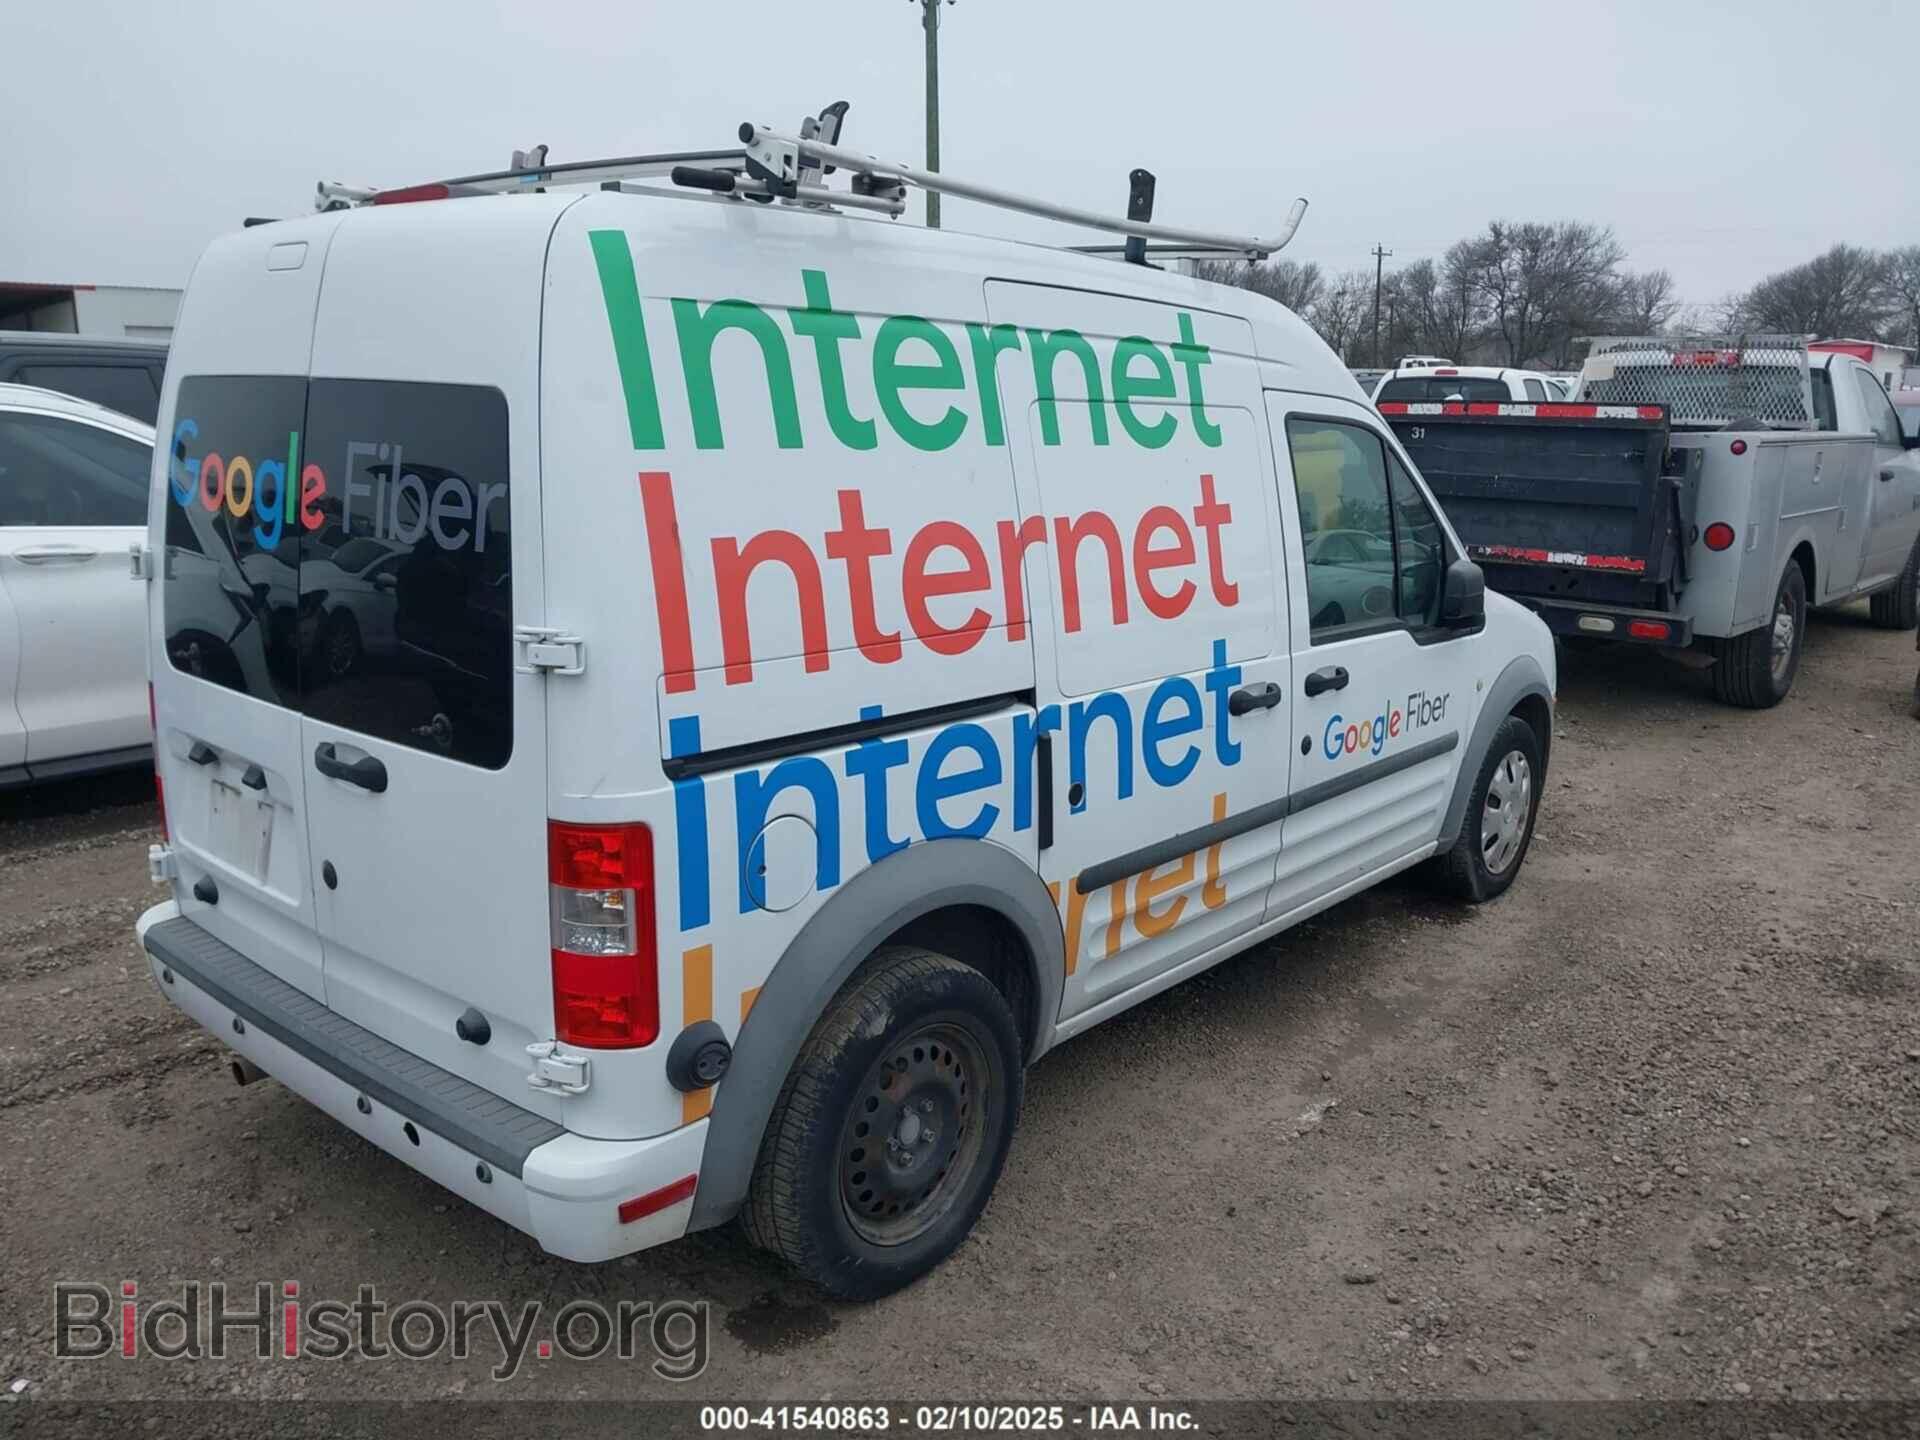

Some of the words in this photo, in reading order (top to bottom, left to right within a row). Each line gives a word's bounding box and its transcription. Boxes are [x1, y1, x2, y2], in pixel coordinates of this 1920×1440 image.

[588, 230, 1222, 451] Internet
[170, 419, 327, 550] Google
[343, 441, 508, 552] Fiber
[1411, 427, 1425, 439] 31
[638, 471, 1239, 694] Internet
[669, 638, 1243, 932] Internet
[1324, 700, 1401, 760] Google
[1406, 690, 1450, 732] Fiber
